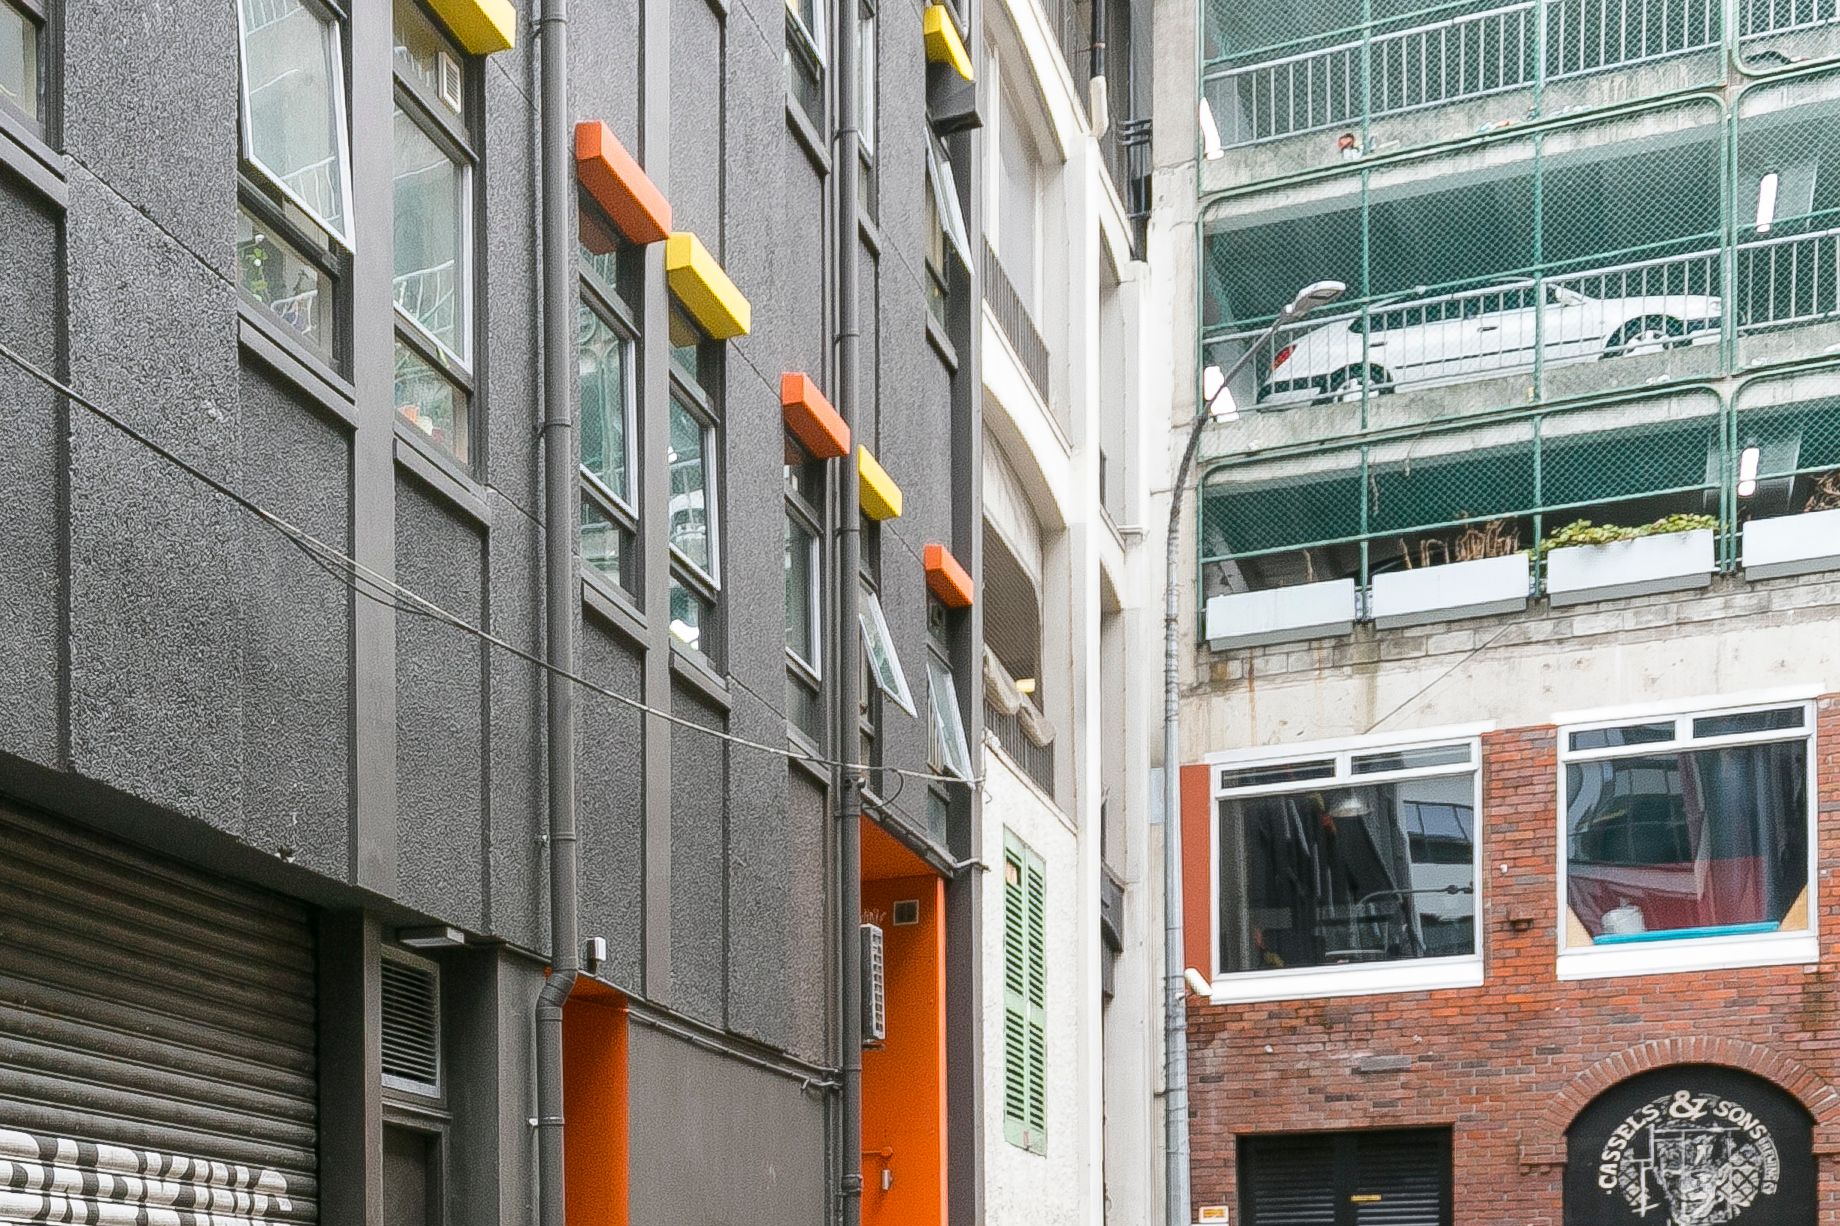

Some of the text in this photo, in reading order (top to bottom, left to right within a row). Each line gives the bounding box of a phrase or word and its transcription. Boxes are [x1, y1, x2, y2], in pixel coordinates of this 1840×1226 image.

[1597, 1089, 1769, 1190] CASSELS & SONS
